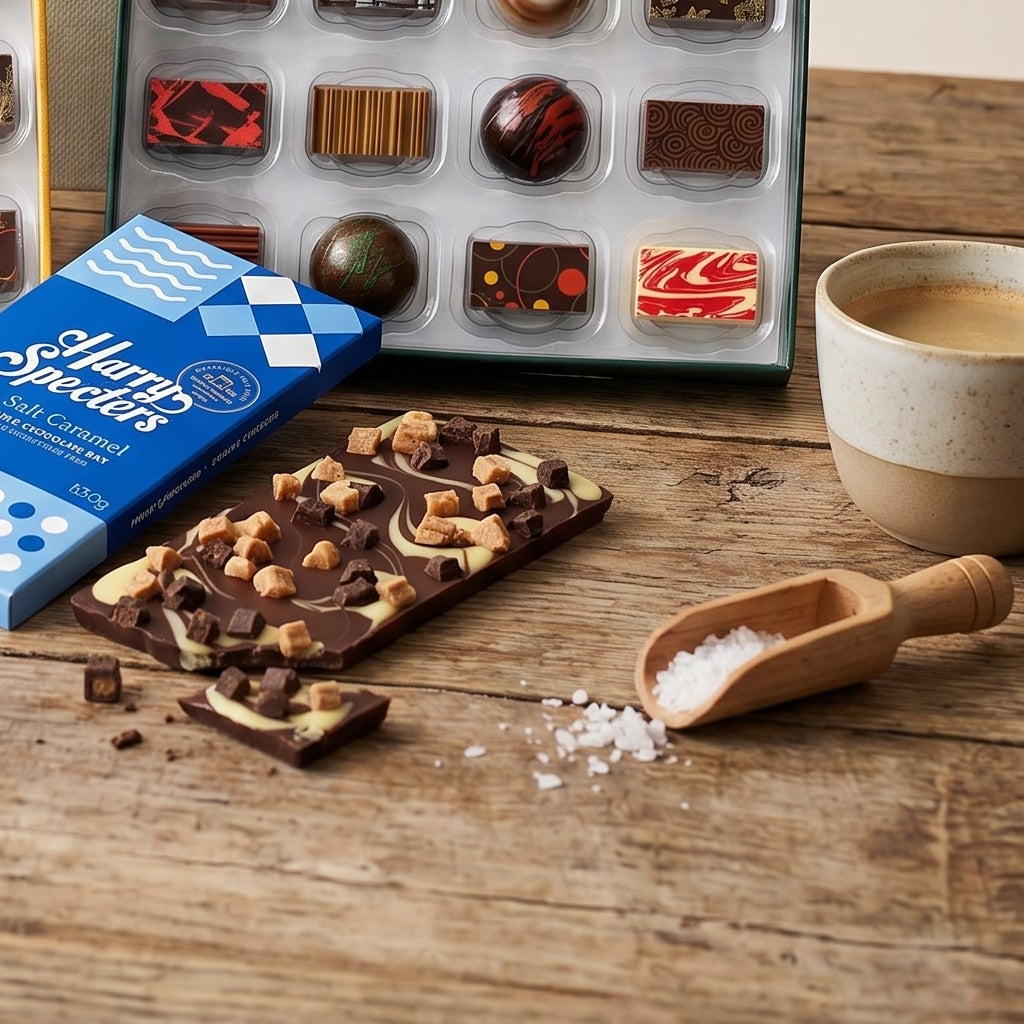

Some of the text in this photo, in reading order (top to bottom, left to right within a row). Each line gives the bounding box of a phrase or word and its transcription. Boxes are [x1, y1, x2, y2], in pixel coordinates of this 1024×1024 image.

[58, 329, 194, 414] Harry
[2, 394, 45, 419] Salt
[47, 413, 130, 457] Caramel
